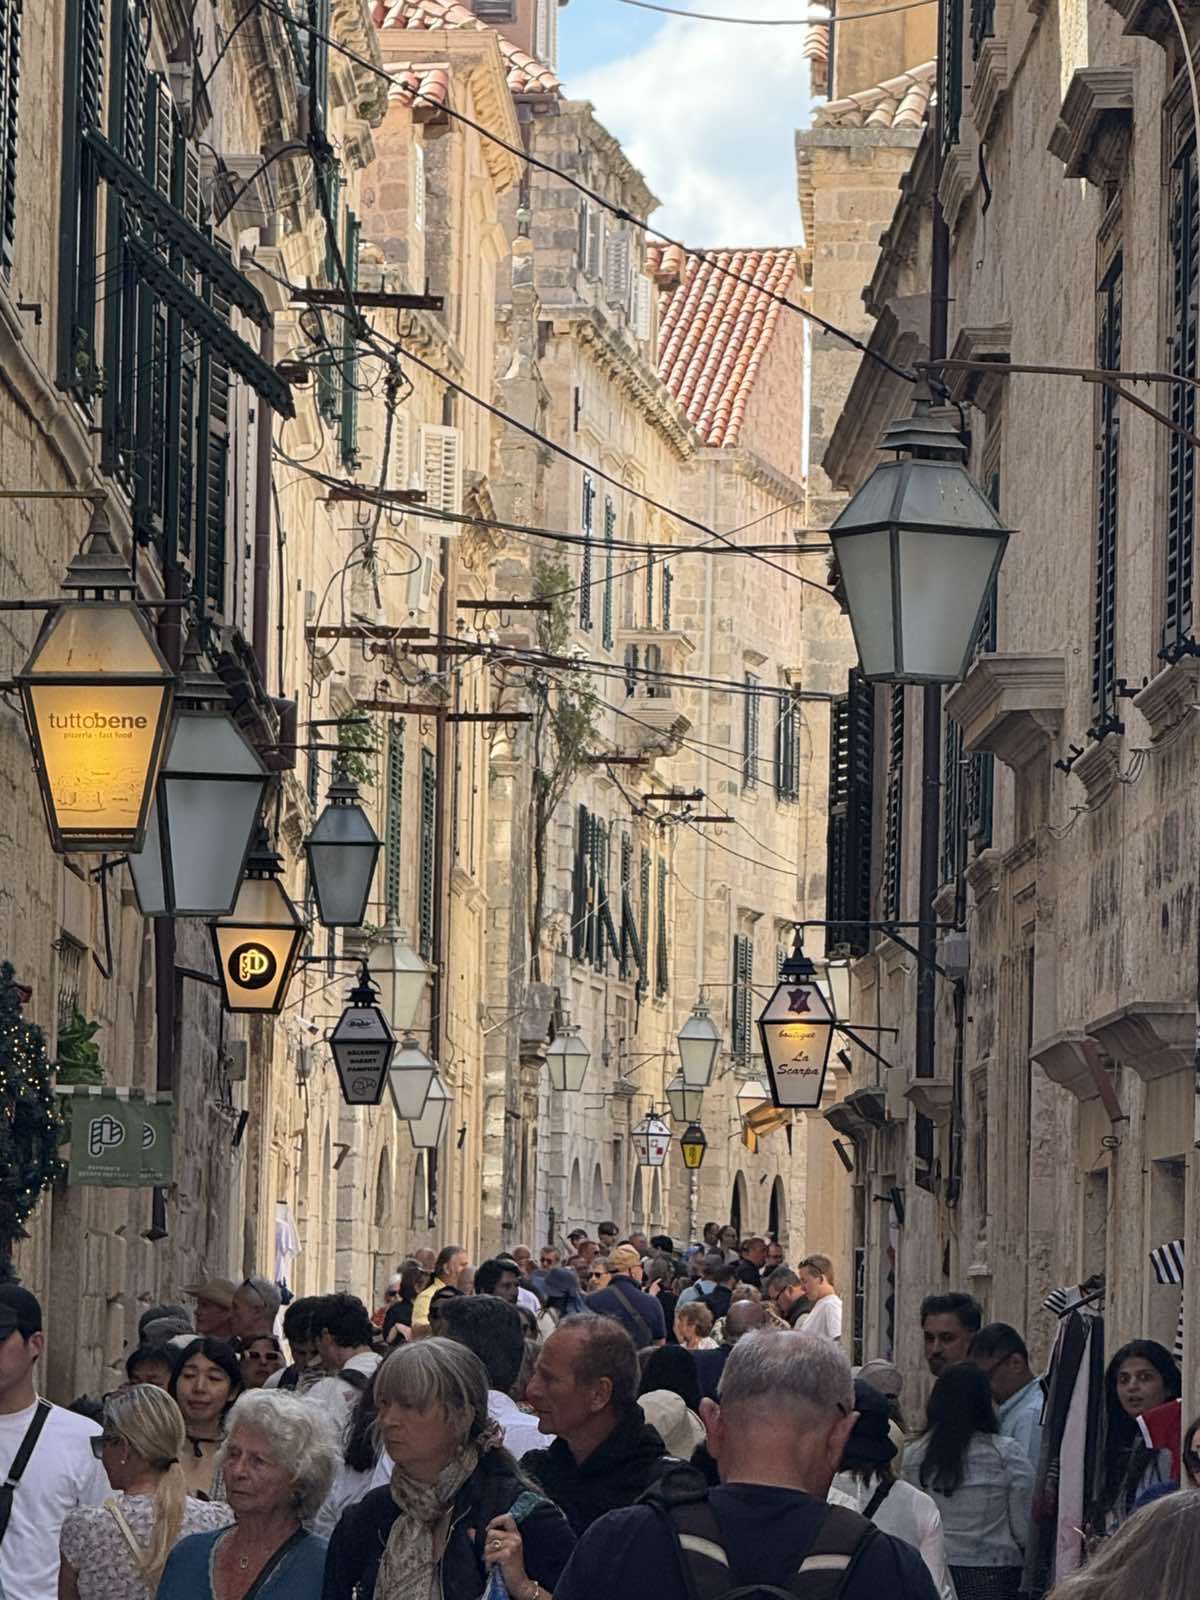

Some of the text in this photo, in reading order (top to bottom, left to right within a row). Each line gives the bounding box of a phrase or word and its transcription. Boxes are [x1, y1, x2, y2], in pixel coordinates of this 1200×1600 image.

[48, 712, 148, 729] tuttobene
[791, 1050, 809, 1061] La
[777, 1064, 819, 1078] Scarpa
